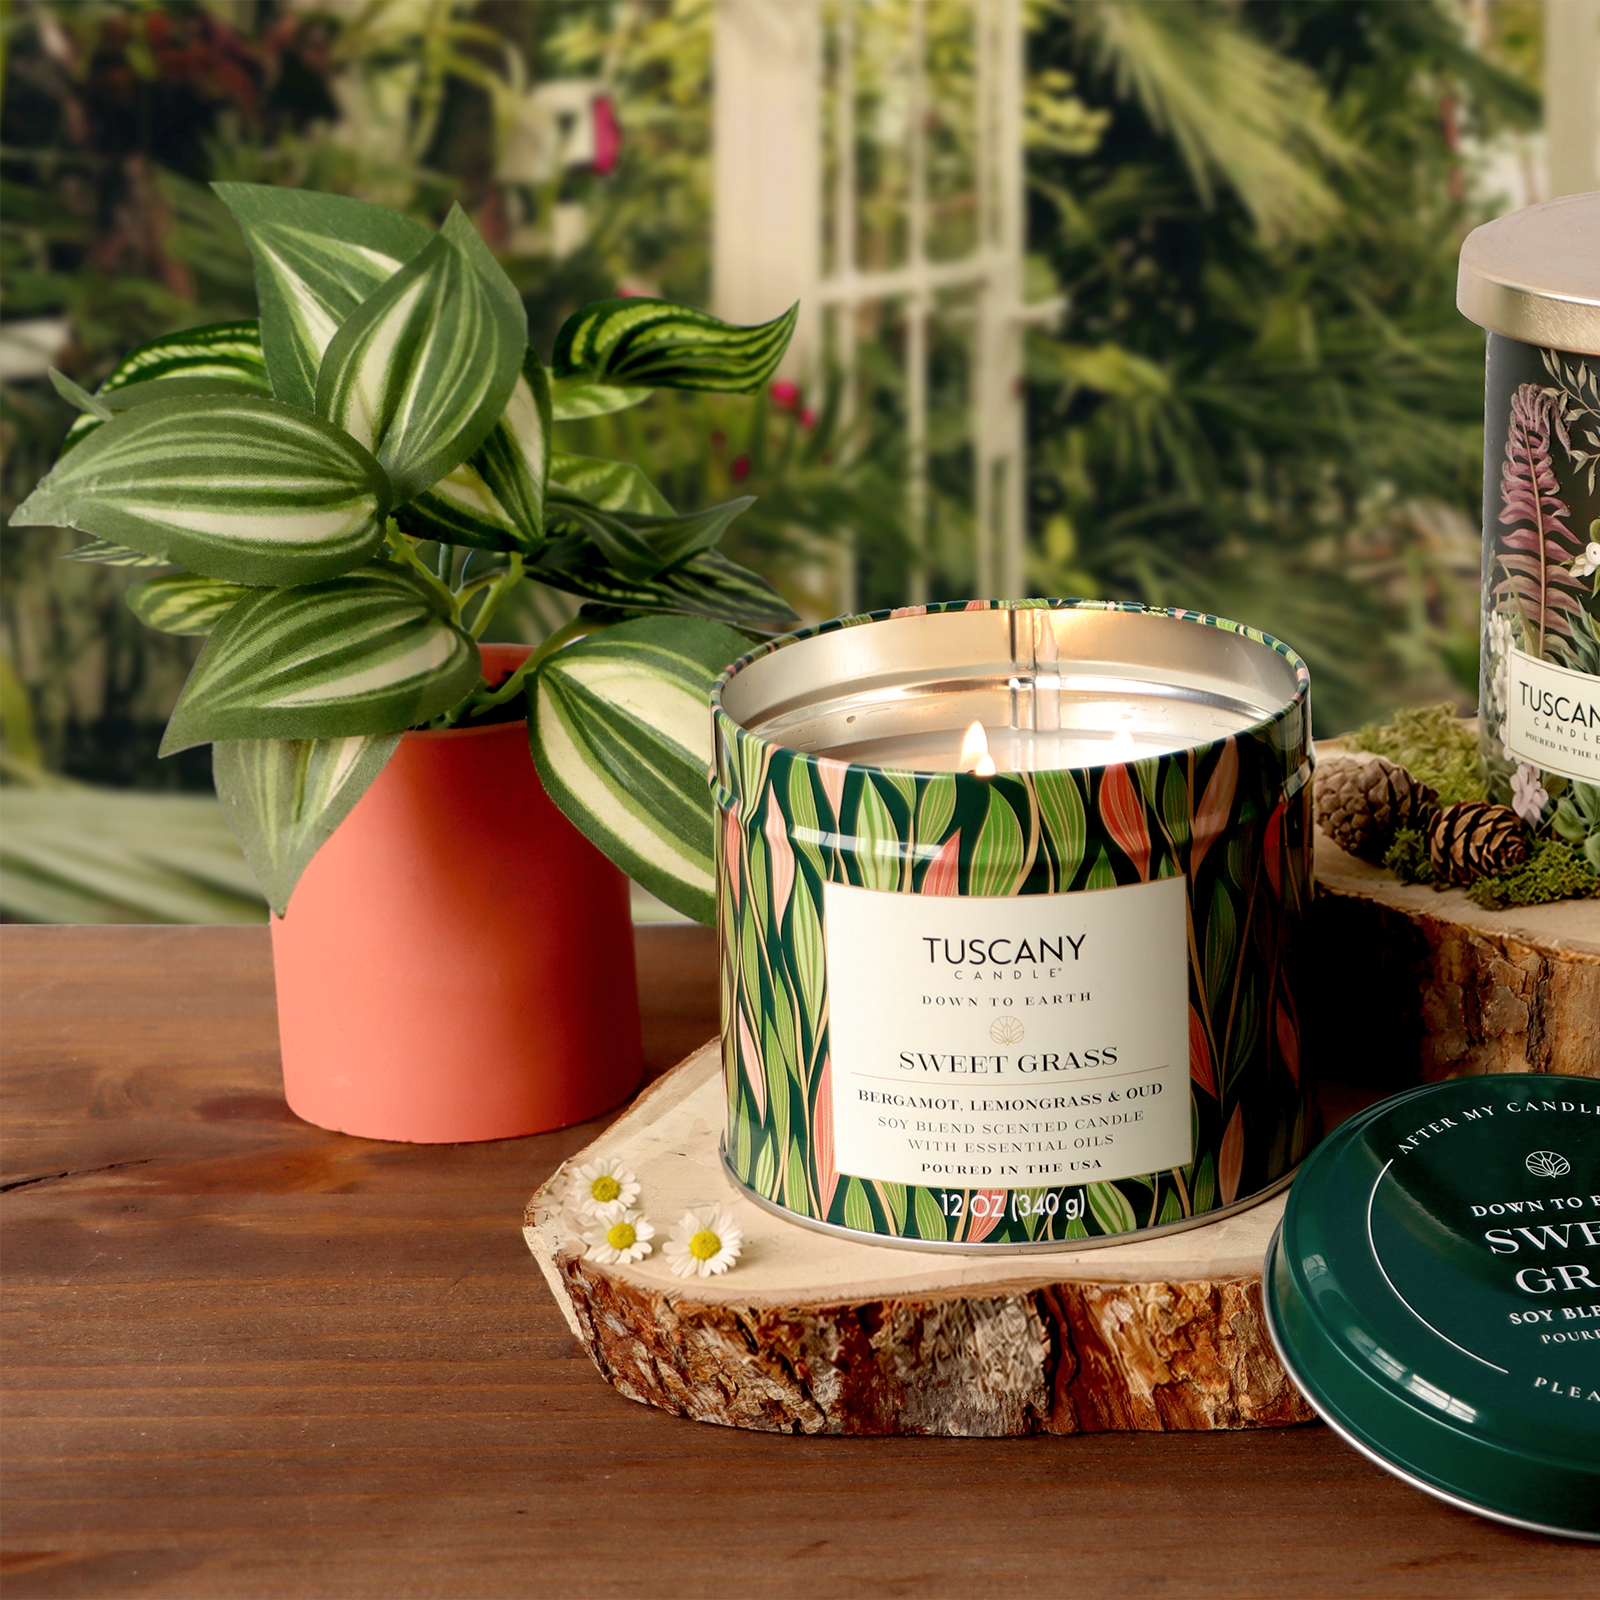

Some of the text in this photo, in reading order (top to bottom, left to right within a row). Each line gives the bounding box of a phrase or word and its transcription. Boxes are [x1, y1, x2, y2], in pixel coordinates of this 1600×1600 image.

[1525, 732, 1555, 748] POURED
[1559, 744, 1568, 752] IN
[1571, 748, 1591, 758] THE
[922, 934, 1087, 965] TUSCANY
[922, 992, 1091, 1007] DOWN TO EARTH
[900, 1047, 1118, 1074] SWEET GRASS
[858, 1083, 1162, 1111] BERGAMOT, LEMONGRASS & OUD
[878, 1111, 1144, 1134] SOY BLEND SCENTED CANDLE
[1398, 1117, 1458, 1154] AFTER
[1465, 1105, 1495, 1123] MY
[908, 1134, 1114, 1153] WITH ESSENTIAL OILS
[921, 1159, 1102, 1175] POURED IN THE USA
[941, 1189, 1086, 1222] 12 OZ (340 g)
[1471, 1199, 1544, 1217] DOWN
[1551, 1196, 1584, 1209] TO
[1509, 1308, 1554, 1325] SOY
